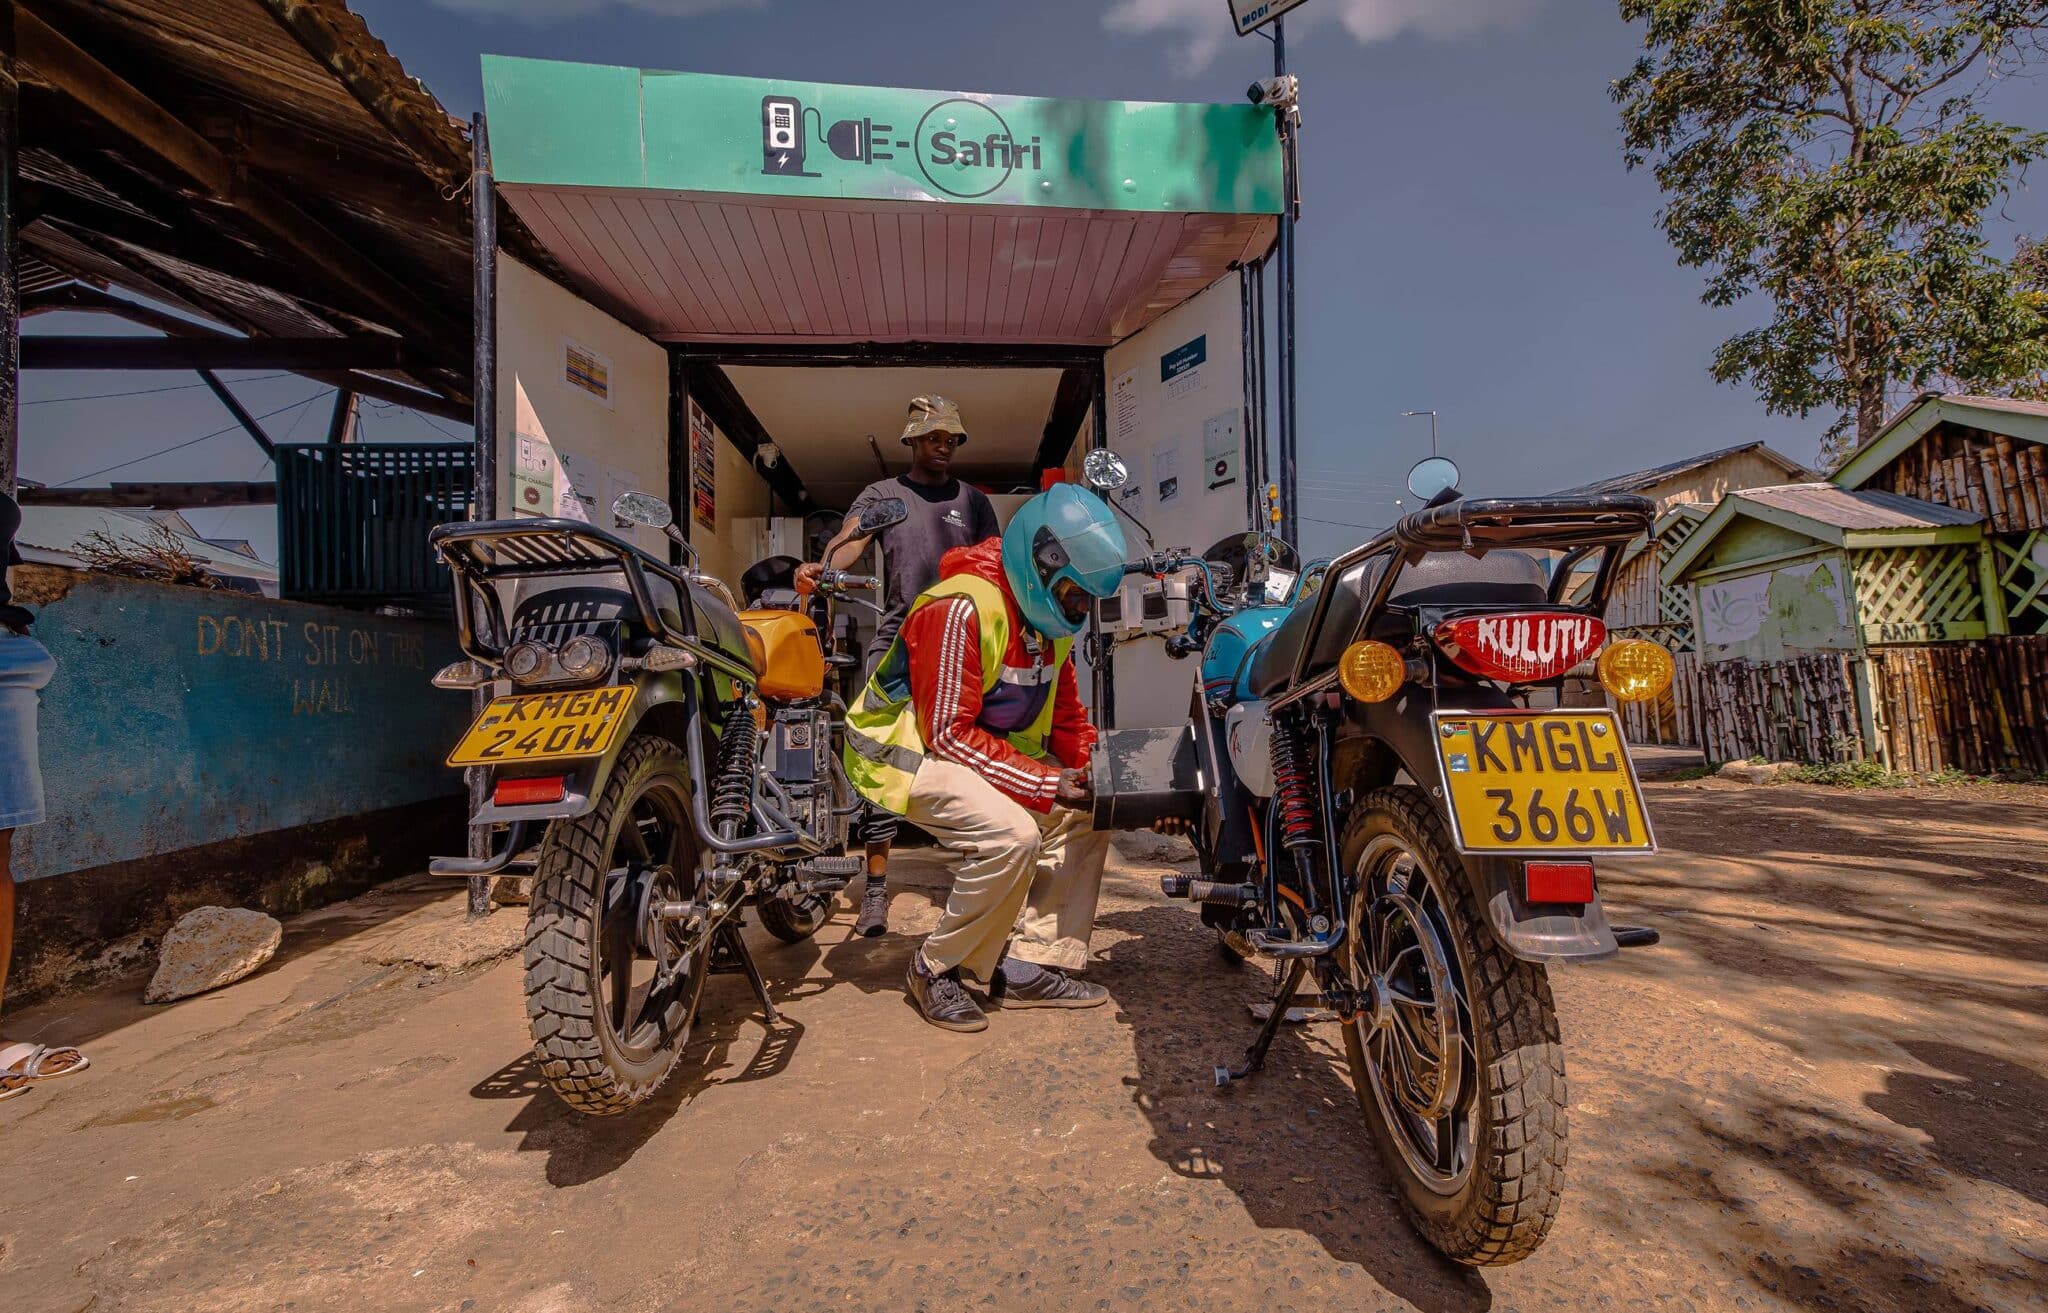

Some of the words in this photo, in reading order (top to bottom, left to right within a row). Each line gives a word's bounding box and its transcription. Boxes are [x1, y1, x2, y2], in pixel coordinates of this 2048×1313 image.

[304, 622, 339, 666] SIT
[350, 629, 379, 665] ON
[388, 631, 424, 670] THIS
[1478, 618, 1591, 674] KULUTU
[504, 689, 624, 723] KMGM
[480, 722, 608, 758] 240W
[1469, 720, 1618, 772] KMGL
[1486, 788, 1632, 843] 366W
